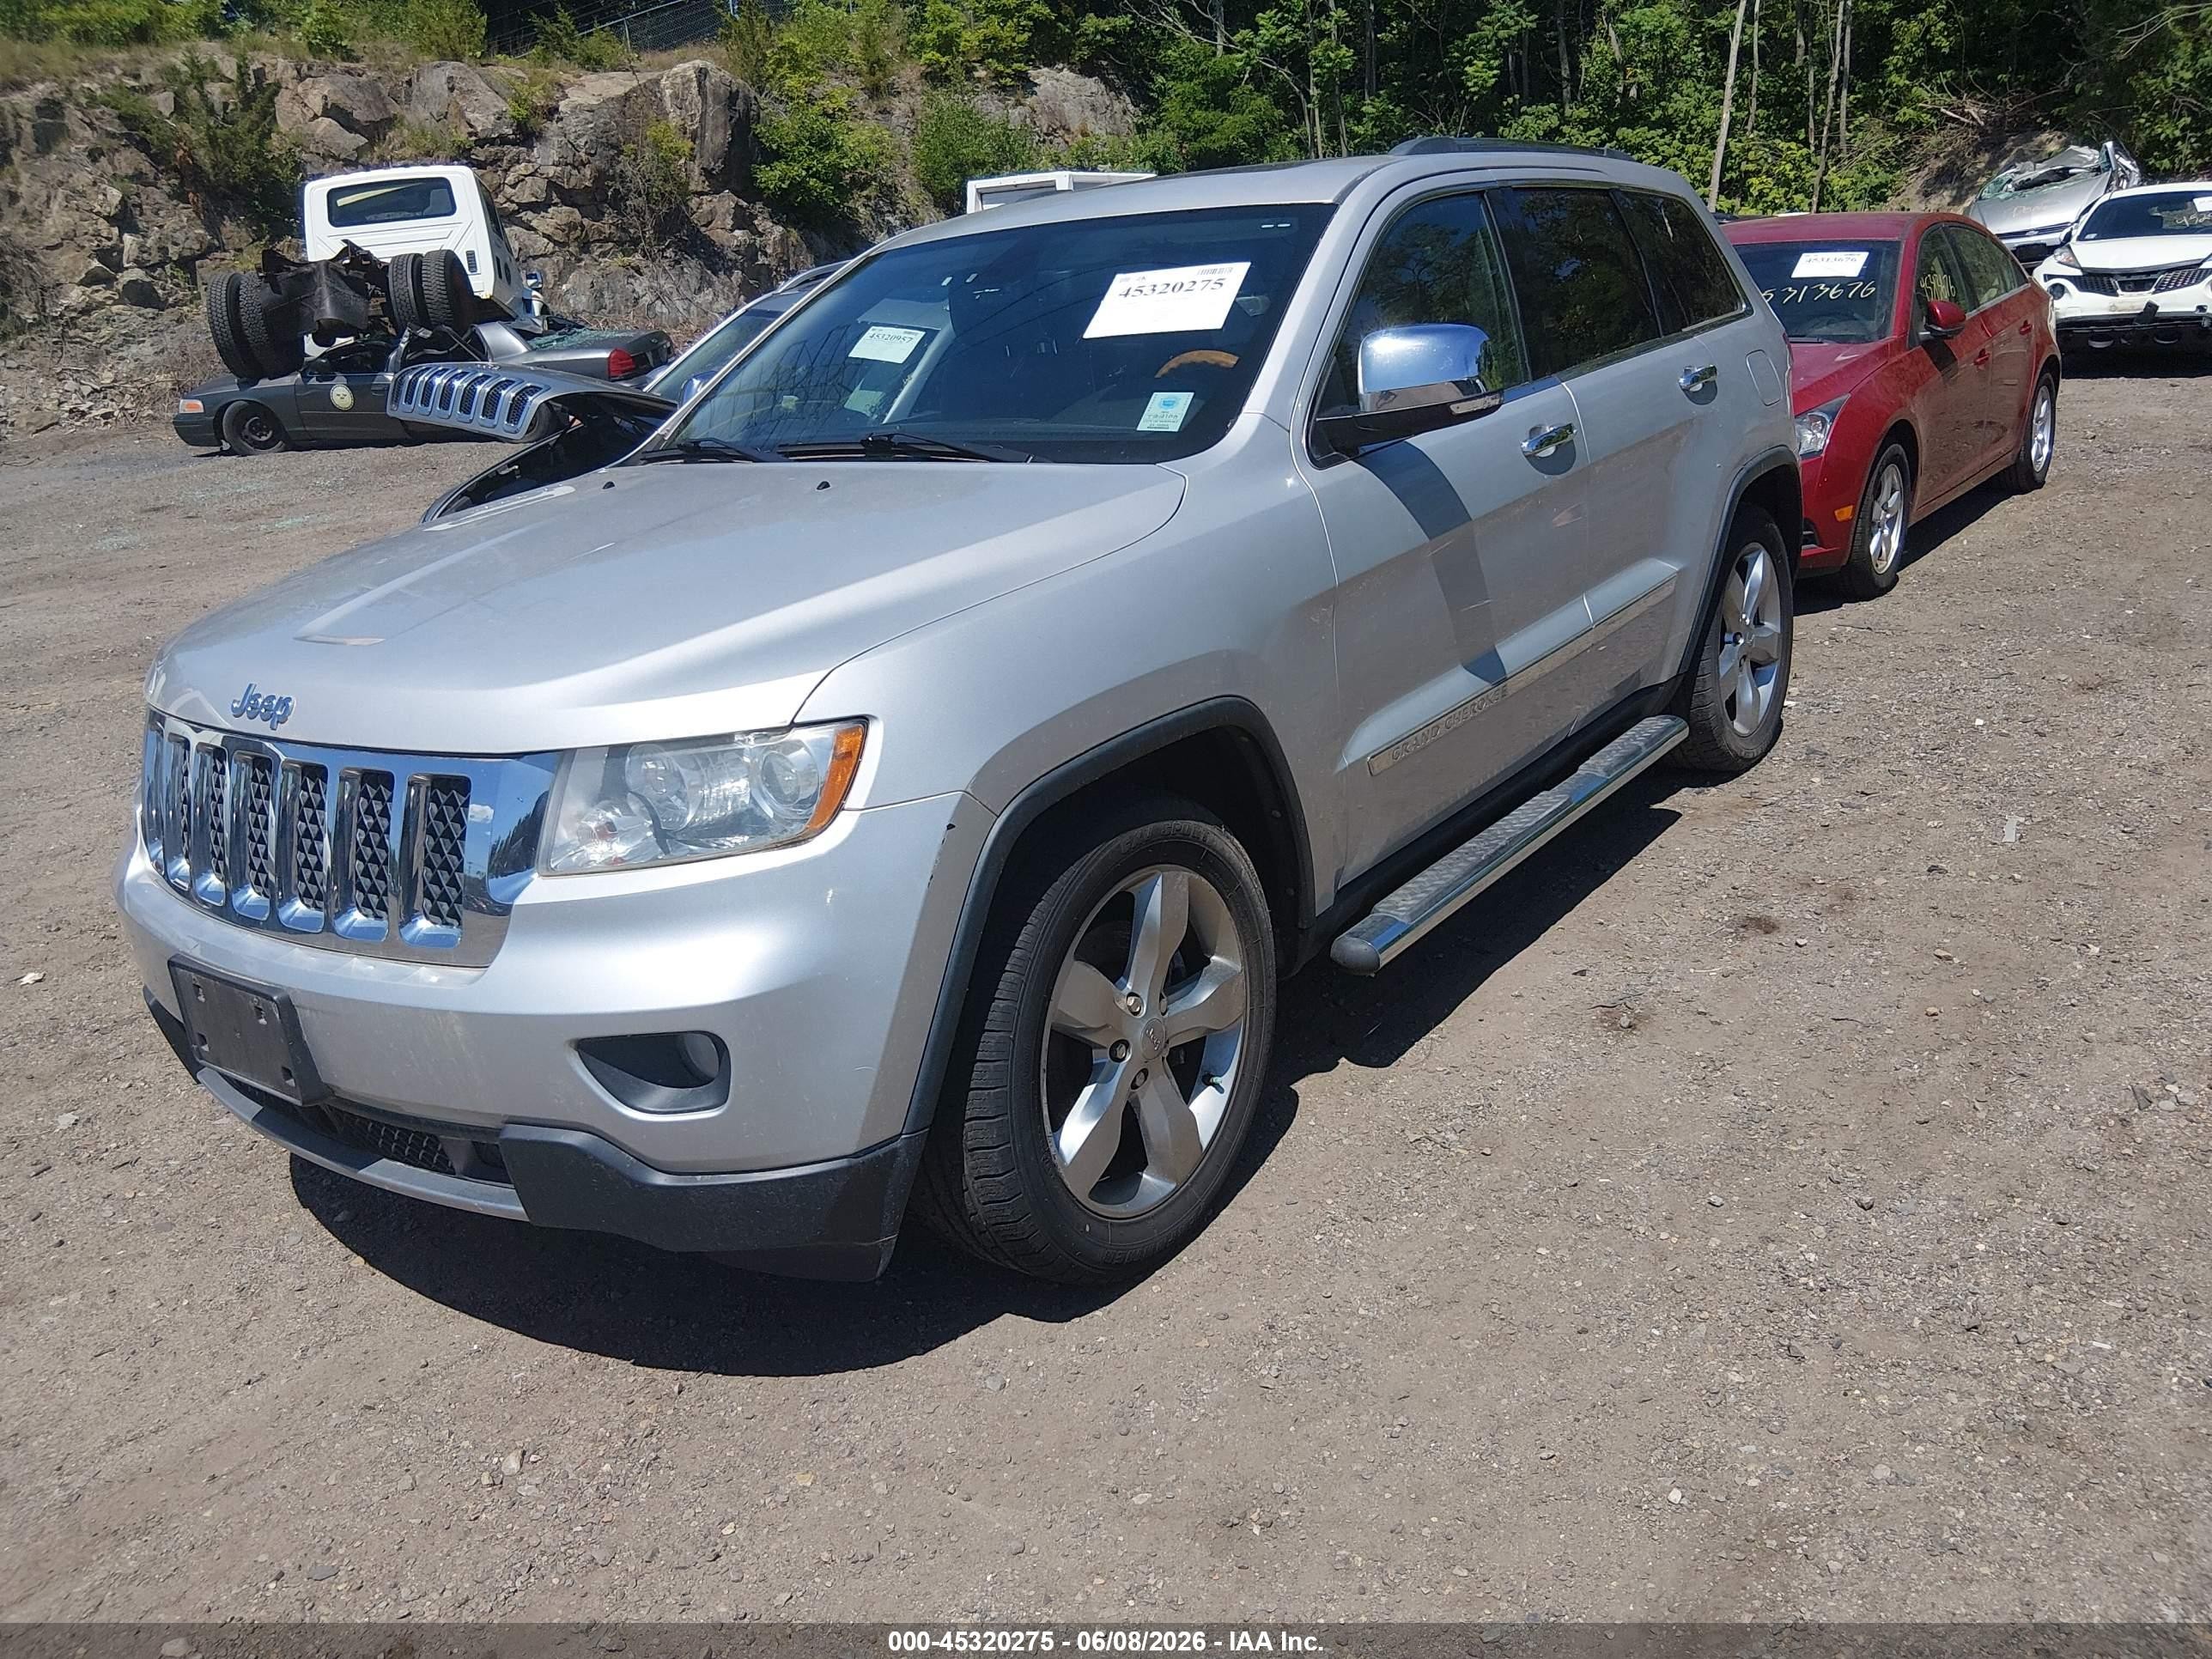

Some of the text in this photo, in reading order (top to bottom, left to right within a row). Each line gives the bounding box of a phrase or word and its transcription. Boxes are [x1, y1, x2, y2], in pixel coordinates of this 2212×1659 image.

[1119, 277, 1226, 298] 45320275
[869, 333, 914, 343] 45320957
[230, 683, 296, 731] Jeep
[1391, 685, 1509, 762] GRAND CHEROKEE
